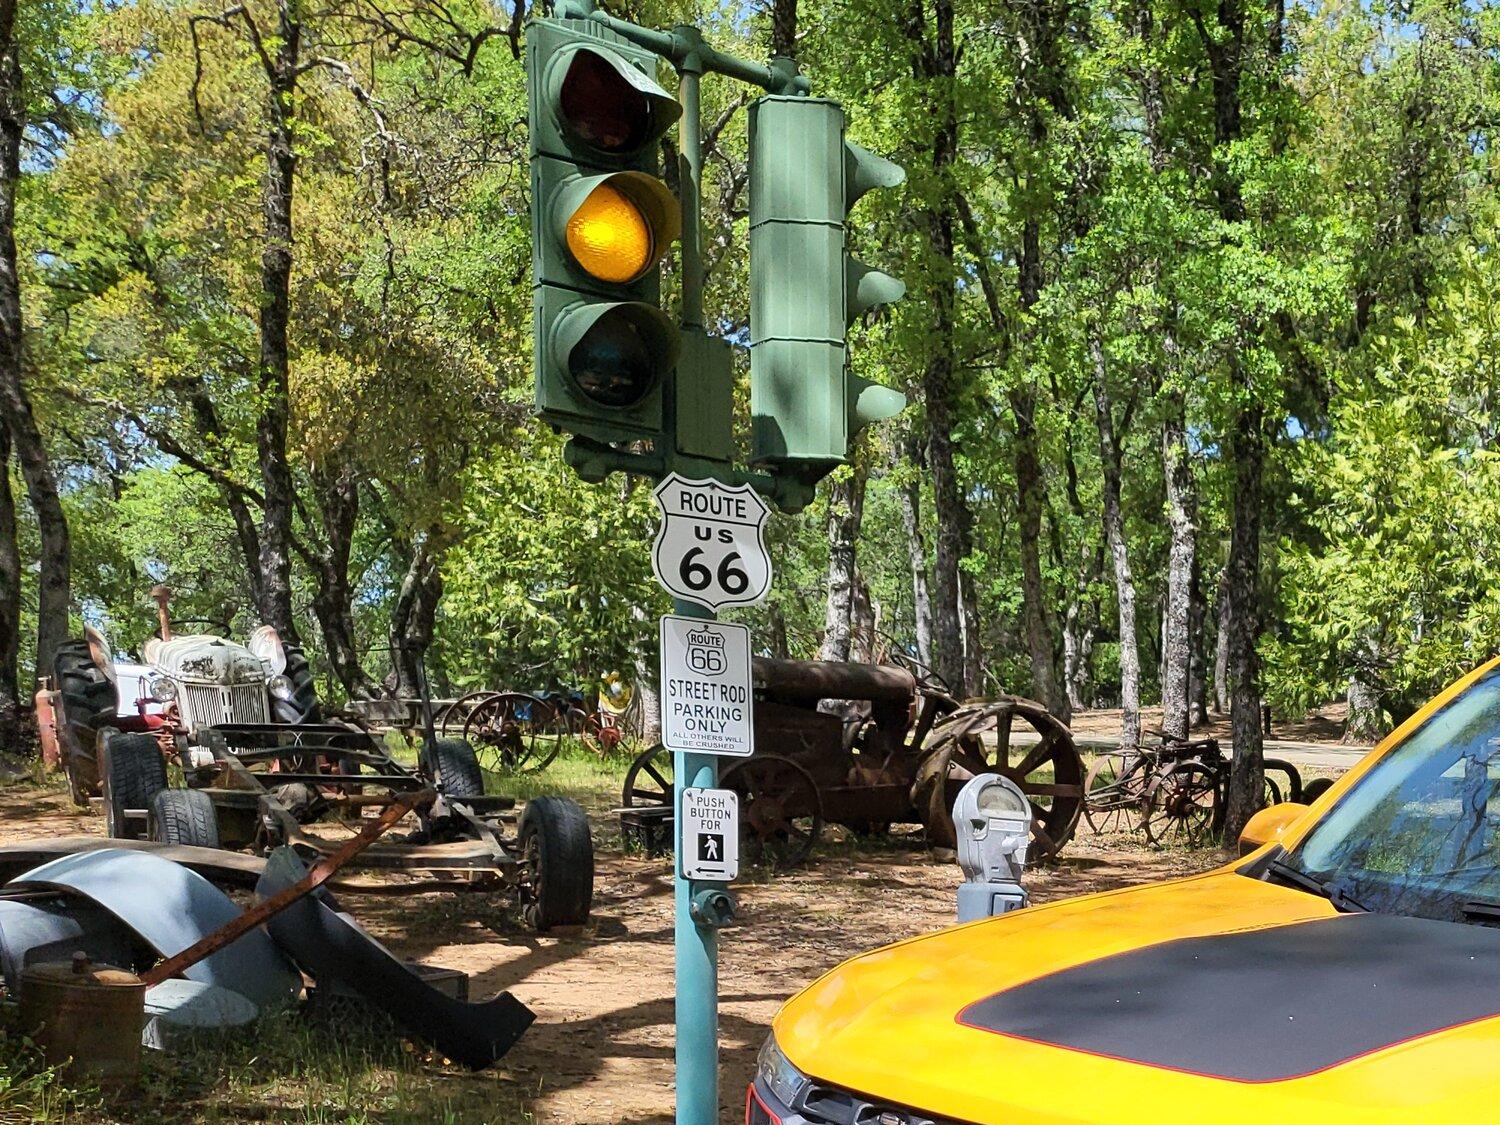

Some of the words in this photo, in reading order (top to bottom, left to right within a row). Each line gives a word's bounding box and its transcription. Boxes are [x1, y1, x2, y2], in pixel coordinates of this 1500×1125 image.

[680, 490, 747, 519] ROUTE
[694, 525, 734, 544] US
[679, 546, 749, 595] 66
[690, 633, 721, 646] ROUTE
[691, 647, 722, 671] 66
[669, 679, 717, 701] STREET
[720, 684, 746, 703] ROD
[674, 702, 742, 721] PARKING
[685, 718, 727, 733] ONLY
[672, 731, 689, 739] ALL
[690, 733, 723, 742] OTHERS
[724, 735, 744, 744] WILL
[695, 741, 735, 749] CRUSHED
[696, 796, 725, 808] PUSH
[690, 807, 731, 820] BUTTON
[701, 819, 721, 830] FOR
